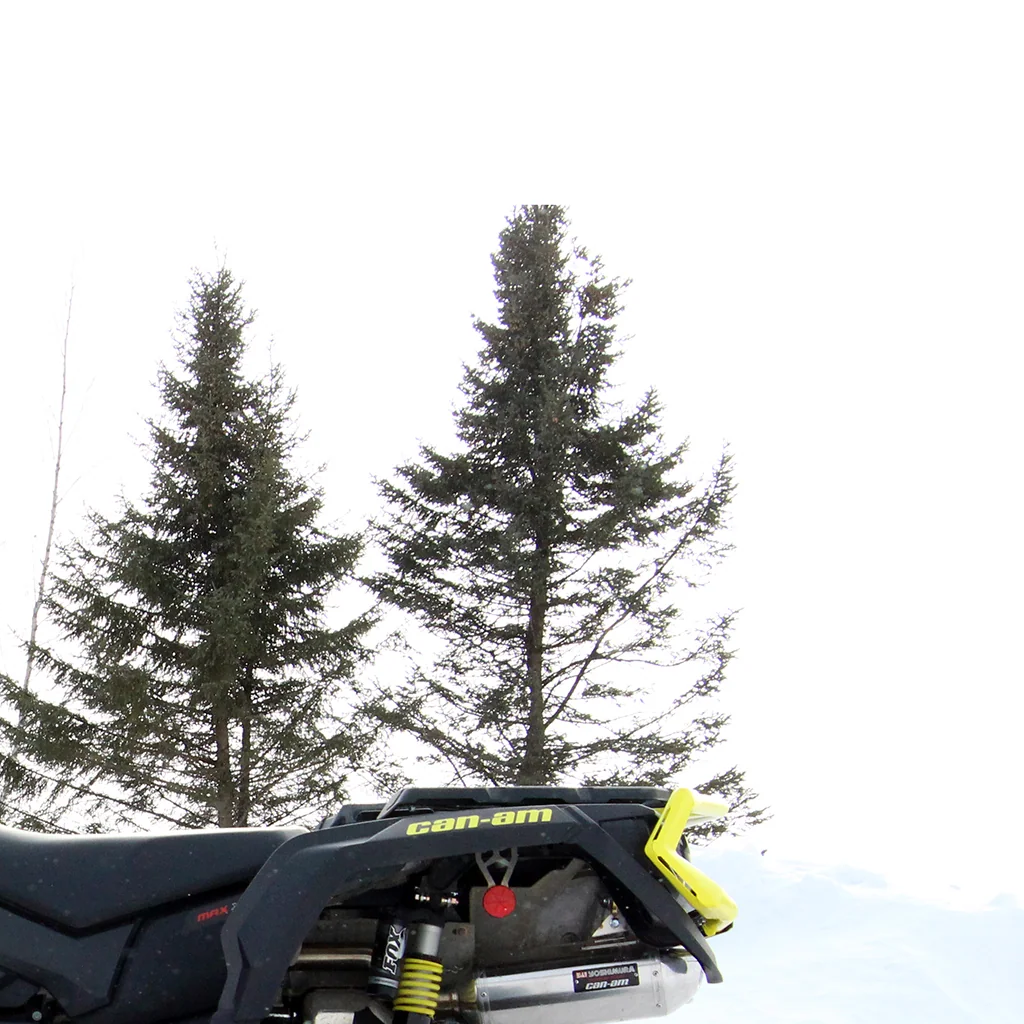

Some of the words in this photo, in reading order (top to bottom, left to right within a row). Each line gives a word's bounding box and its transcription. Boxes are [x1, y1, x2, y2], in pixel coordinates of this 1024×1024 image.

[406, 808, 553, 835] can-am
[382, 925, 406, 975] FOX
[588, 966, 635, 978] YOSHIMURA
[585, 978, 629, 990] can-am
